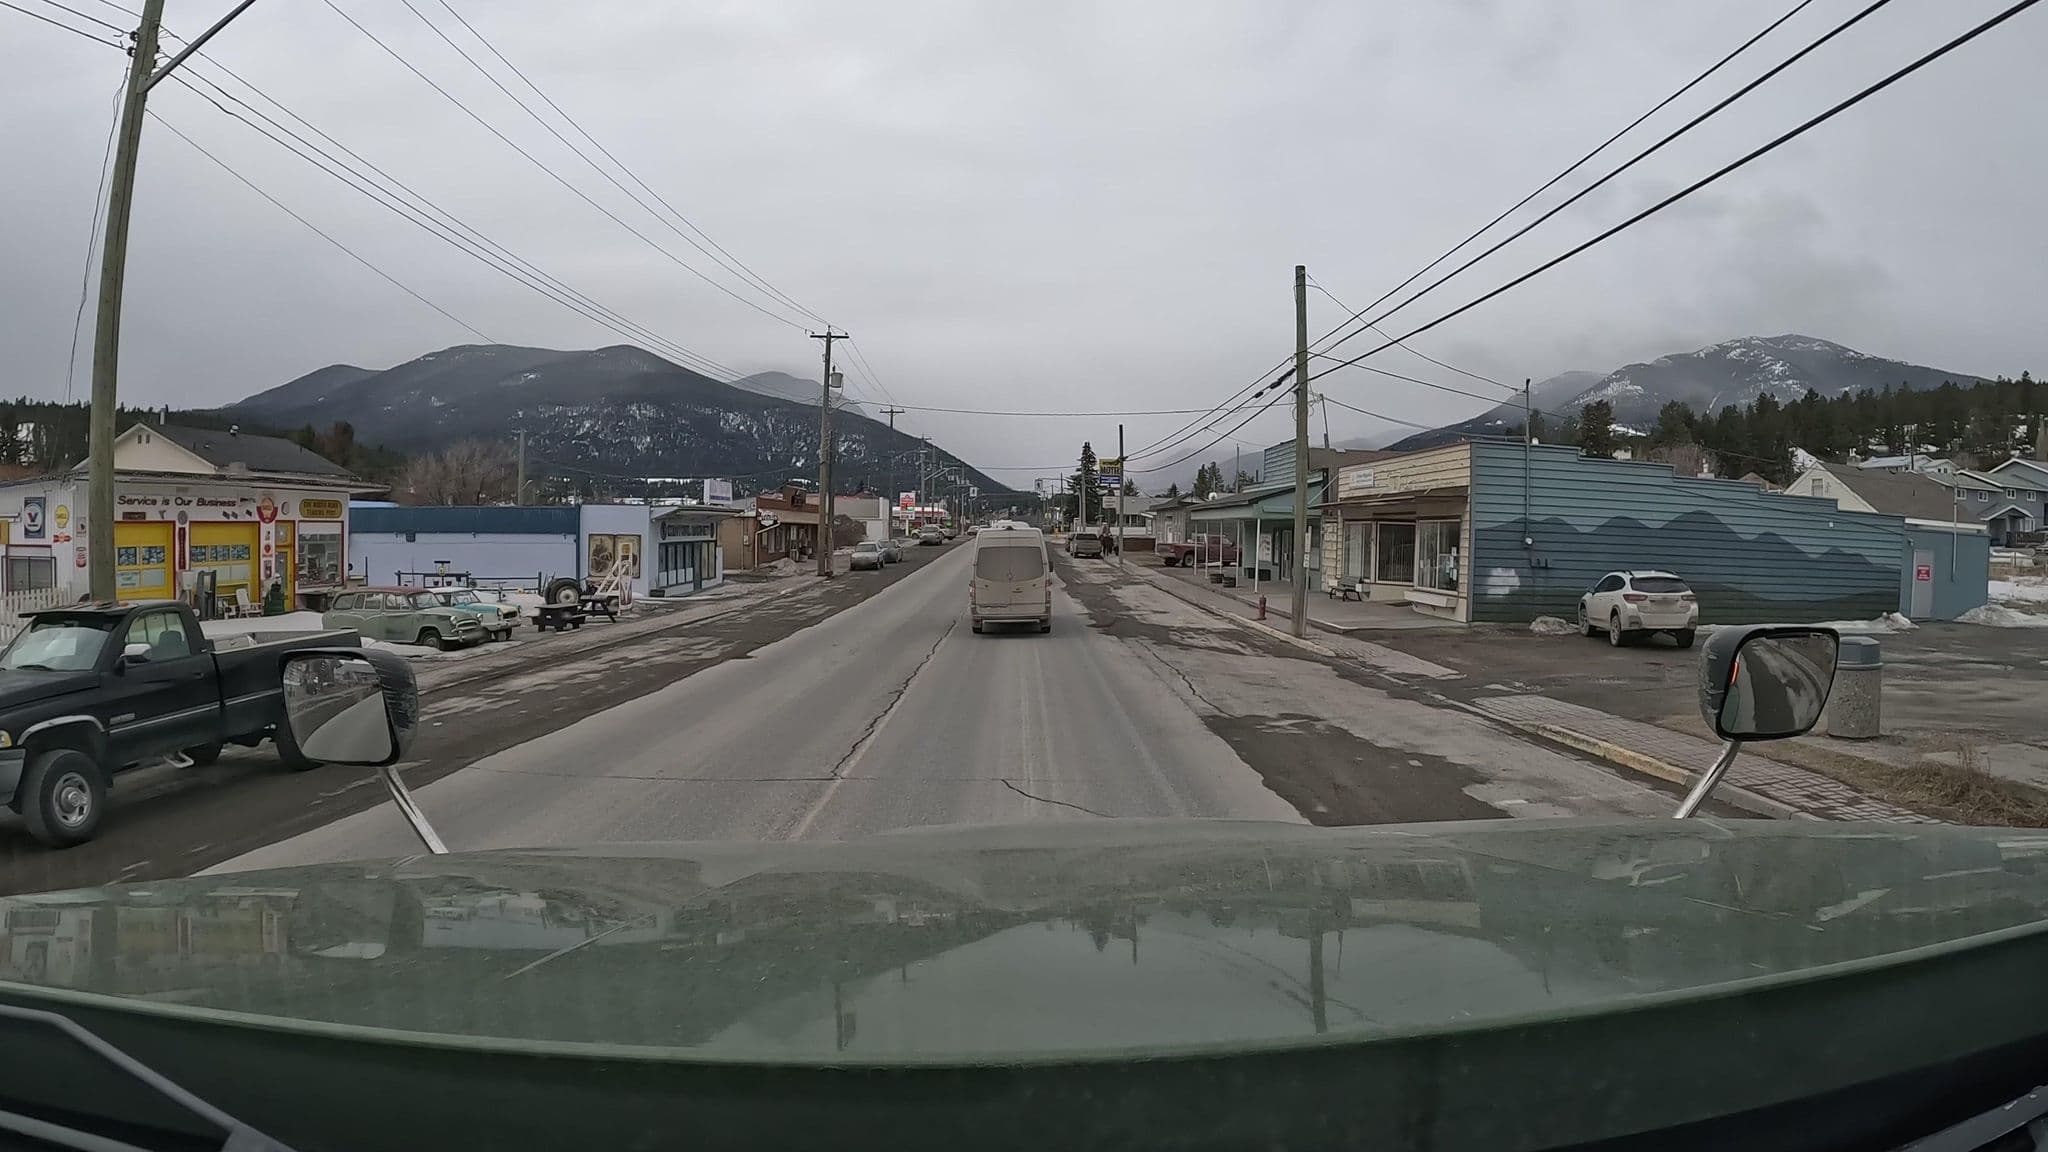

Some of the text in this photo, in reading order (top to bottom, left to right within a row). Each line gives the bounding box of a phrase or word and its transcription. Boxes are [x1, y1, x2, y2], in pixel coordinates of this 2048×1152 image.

[117, 495, 236, 507] Service is Our Business
